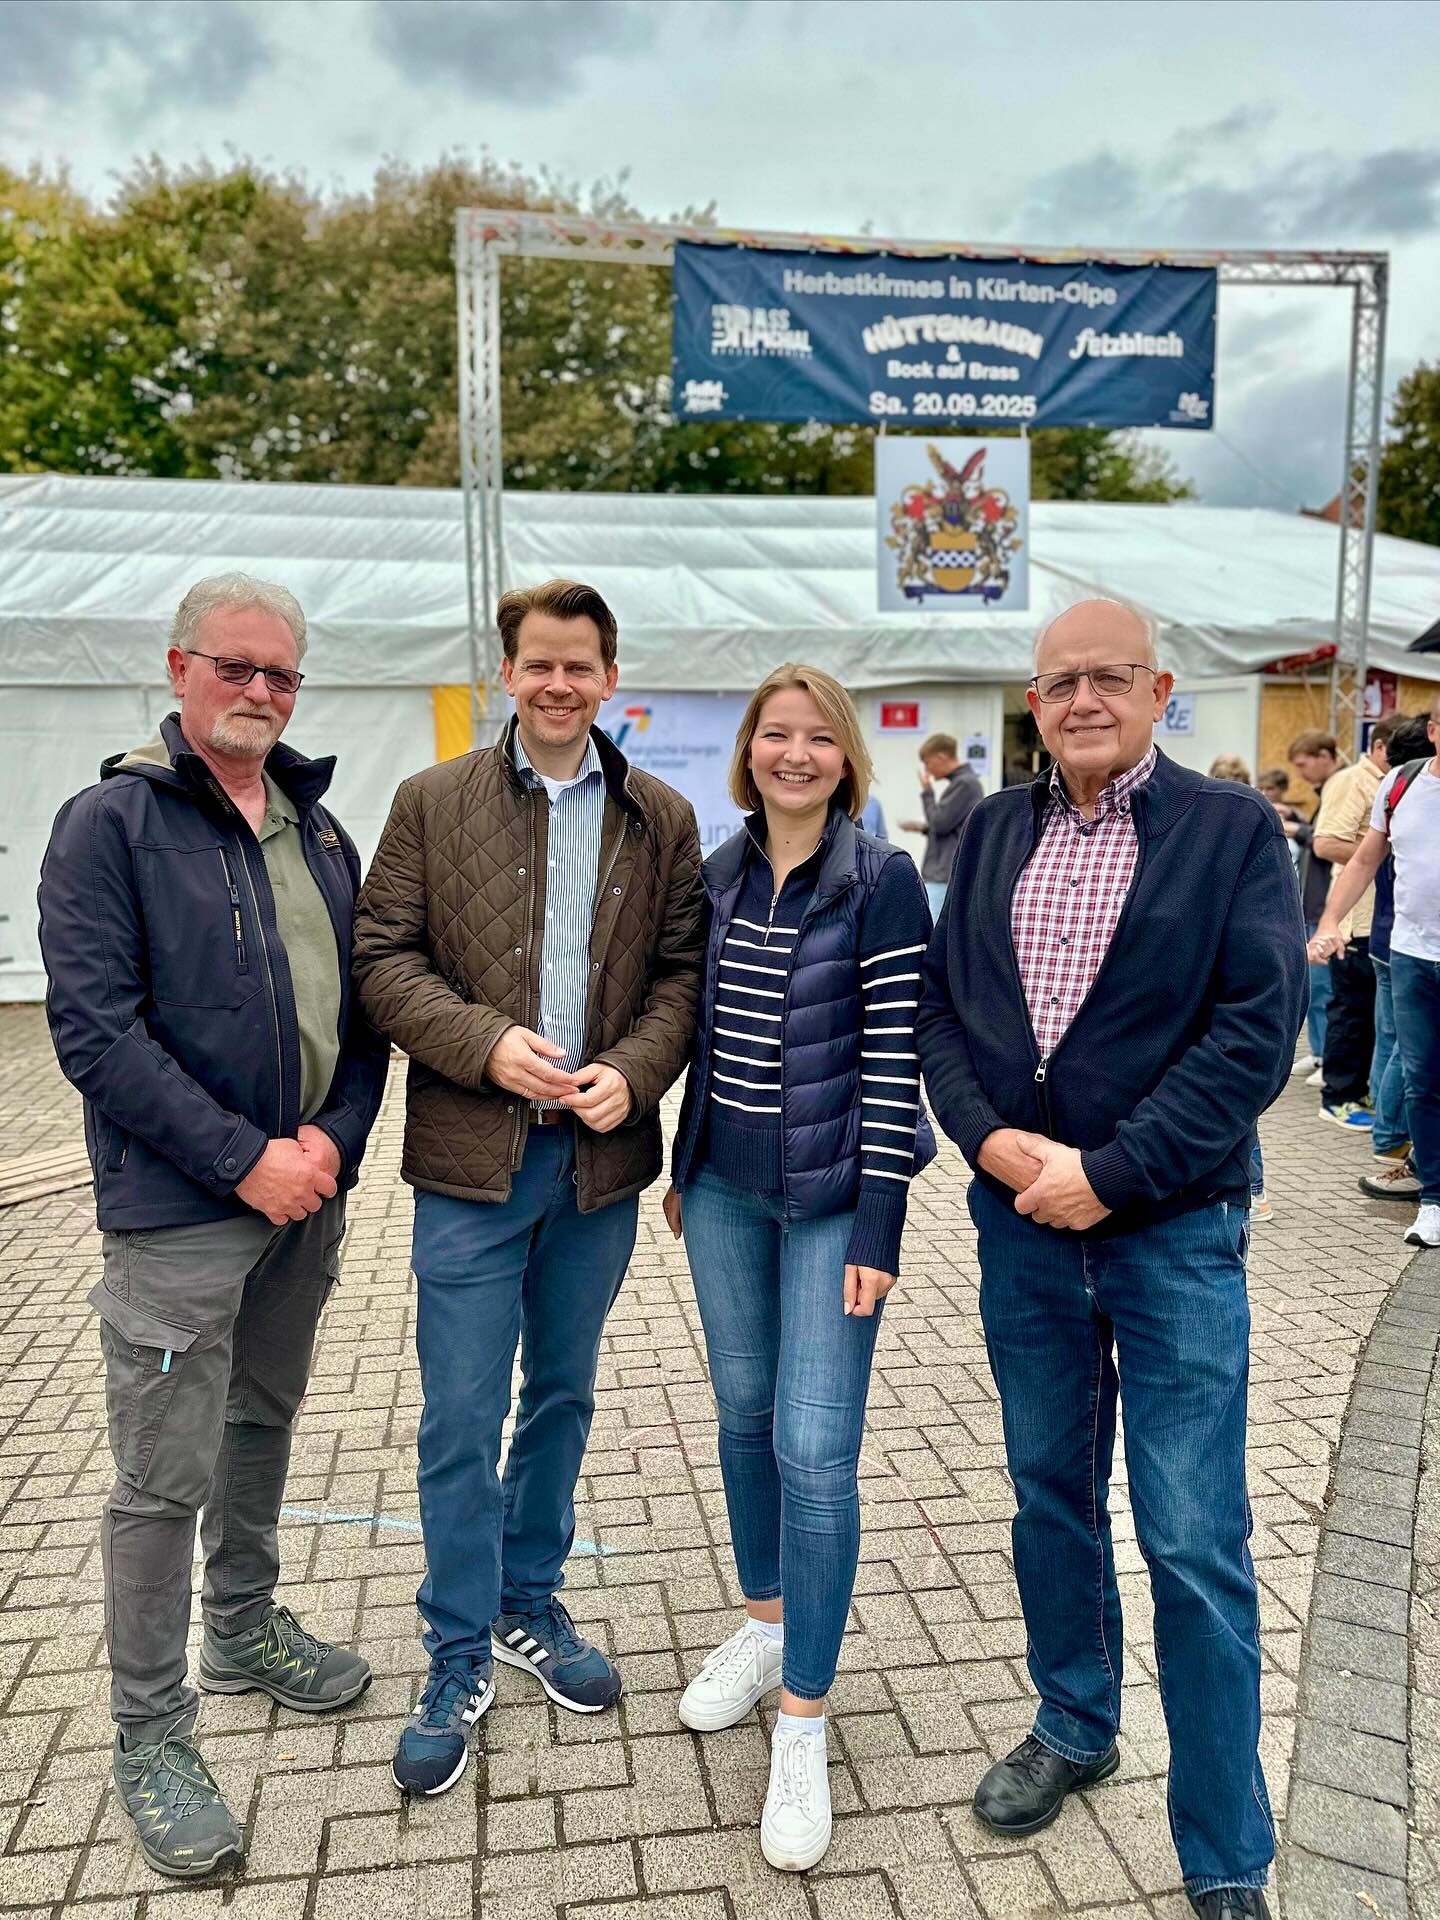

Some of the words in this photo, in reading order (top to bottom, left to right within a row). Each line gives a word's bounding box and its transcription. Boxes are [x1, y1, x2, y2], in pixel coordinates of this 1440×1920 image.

[784, 269, 945, 298] Herbstkirmes
[949, 275, 973, 299] in
[976, 278, 1119, 309] Kürten-Olpe
[886, 359, 935, 379] Bock
[937, 362, 967, 380] auf
[969, 361, 1021, 382] Brass
[868, 391, 908, 415] Sa.
[912, 392, 1038, 418] 20.09.2025
